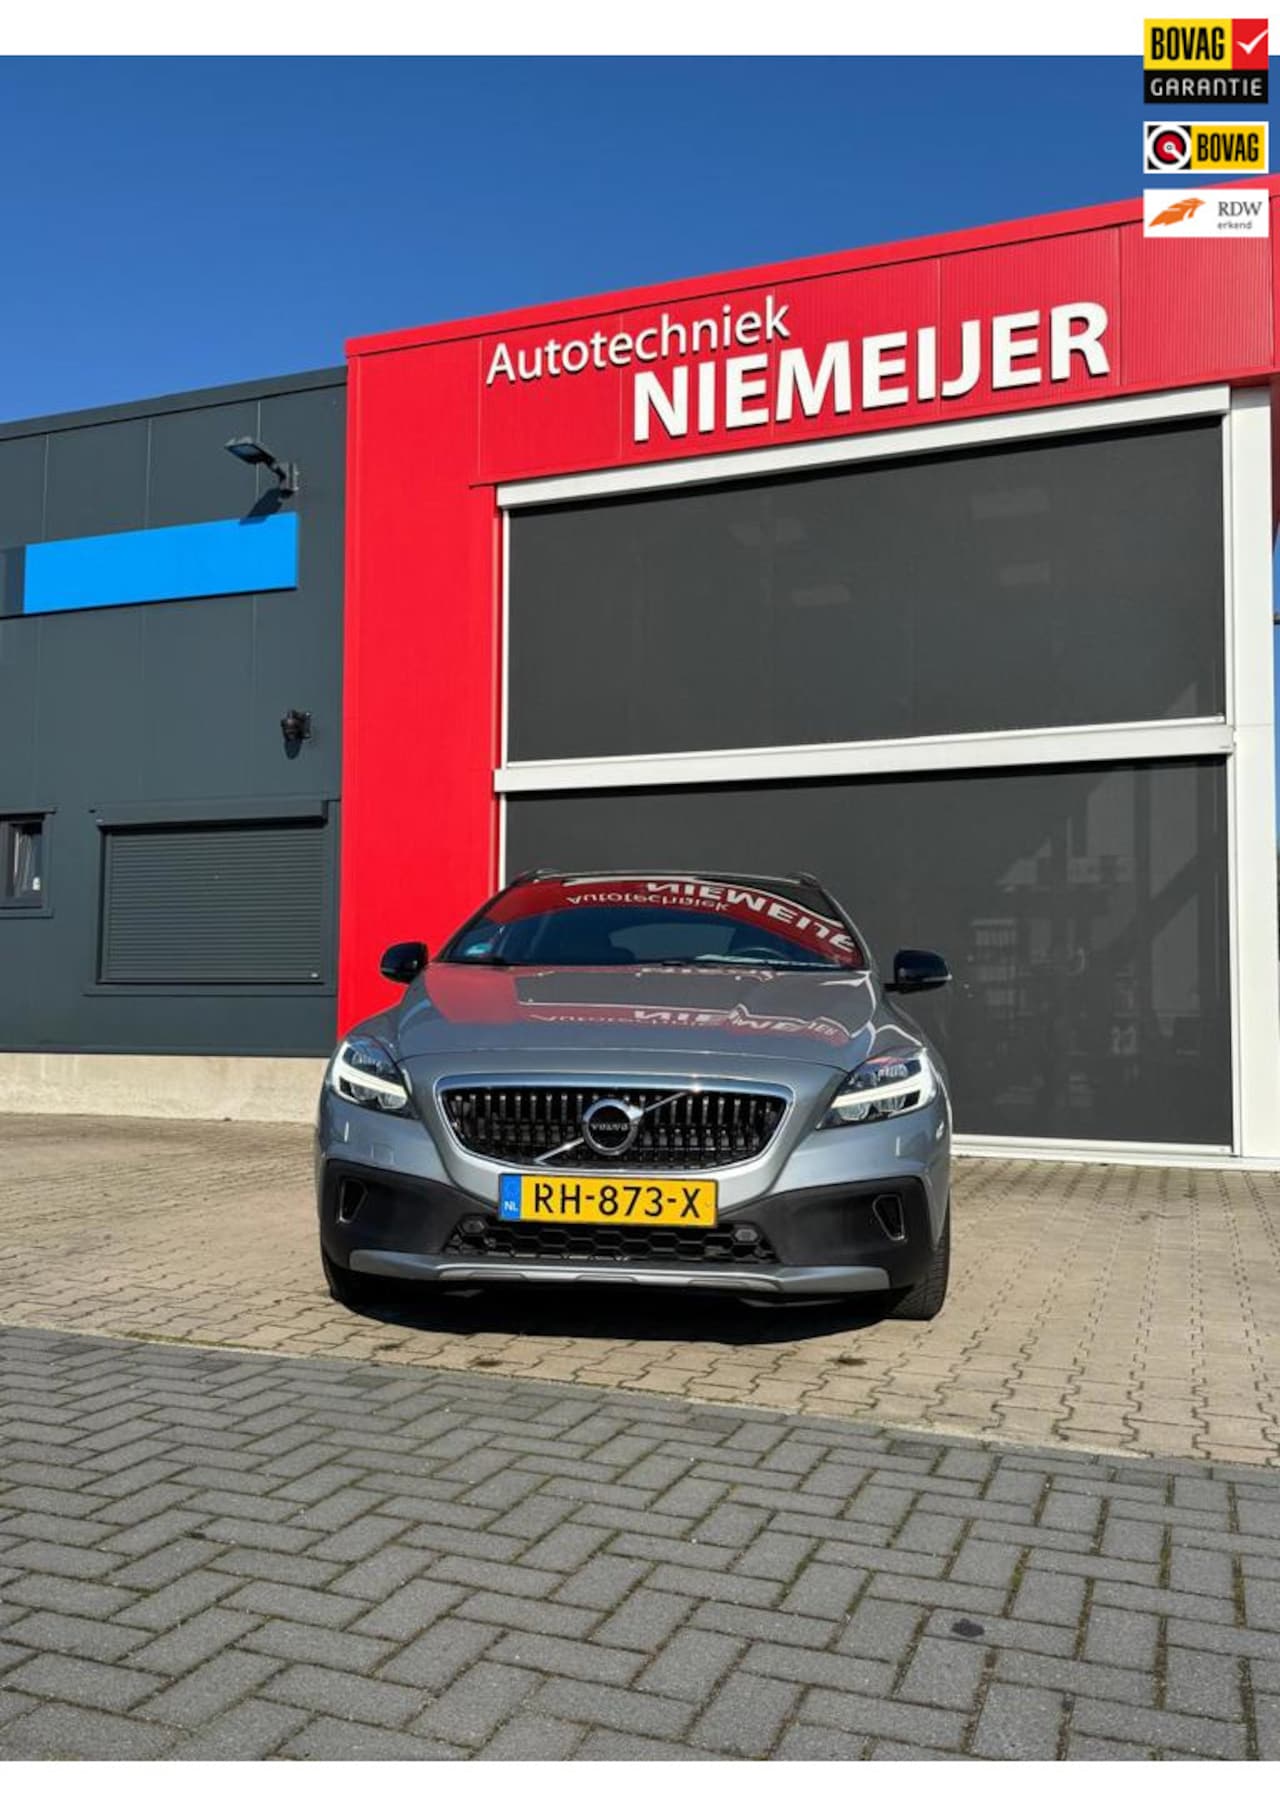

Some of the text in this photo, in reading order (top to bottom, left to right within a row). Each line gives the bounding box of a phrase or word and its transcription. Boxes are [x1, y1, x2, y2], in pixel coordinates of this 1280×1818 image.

[485, 294, 791, 386] Autotechniek
[632, 301, 1111, 443] NIEMEIJER
[590, 1122, 629, 1132] VOLVO
[503, 1200, 519, 1211] NL
[533, 1183, 701, 1219] RH-873-X
